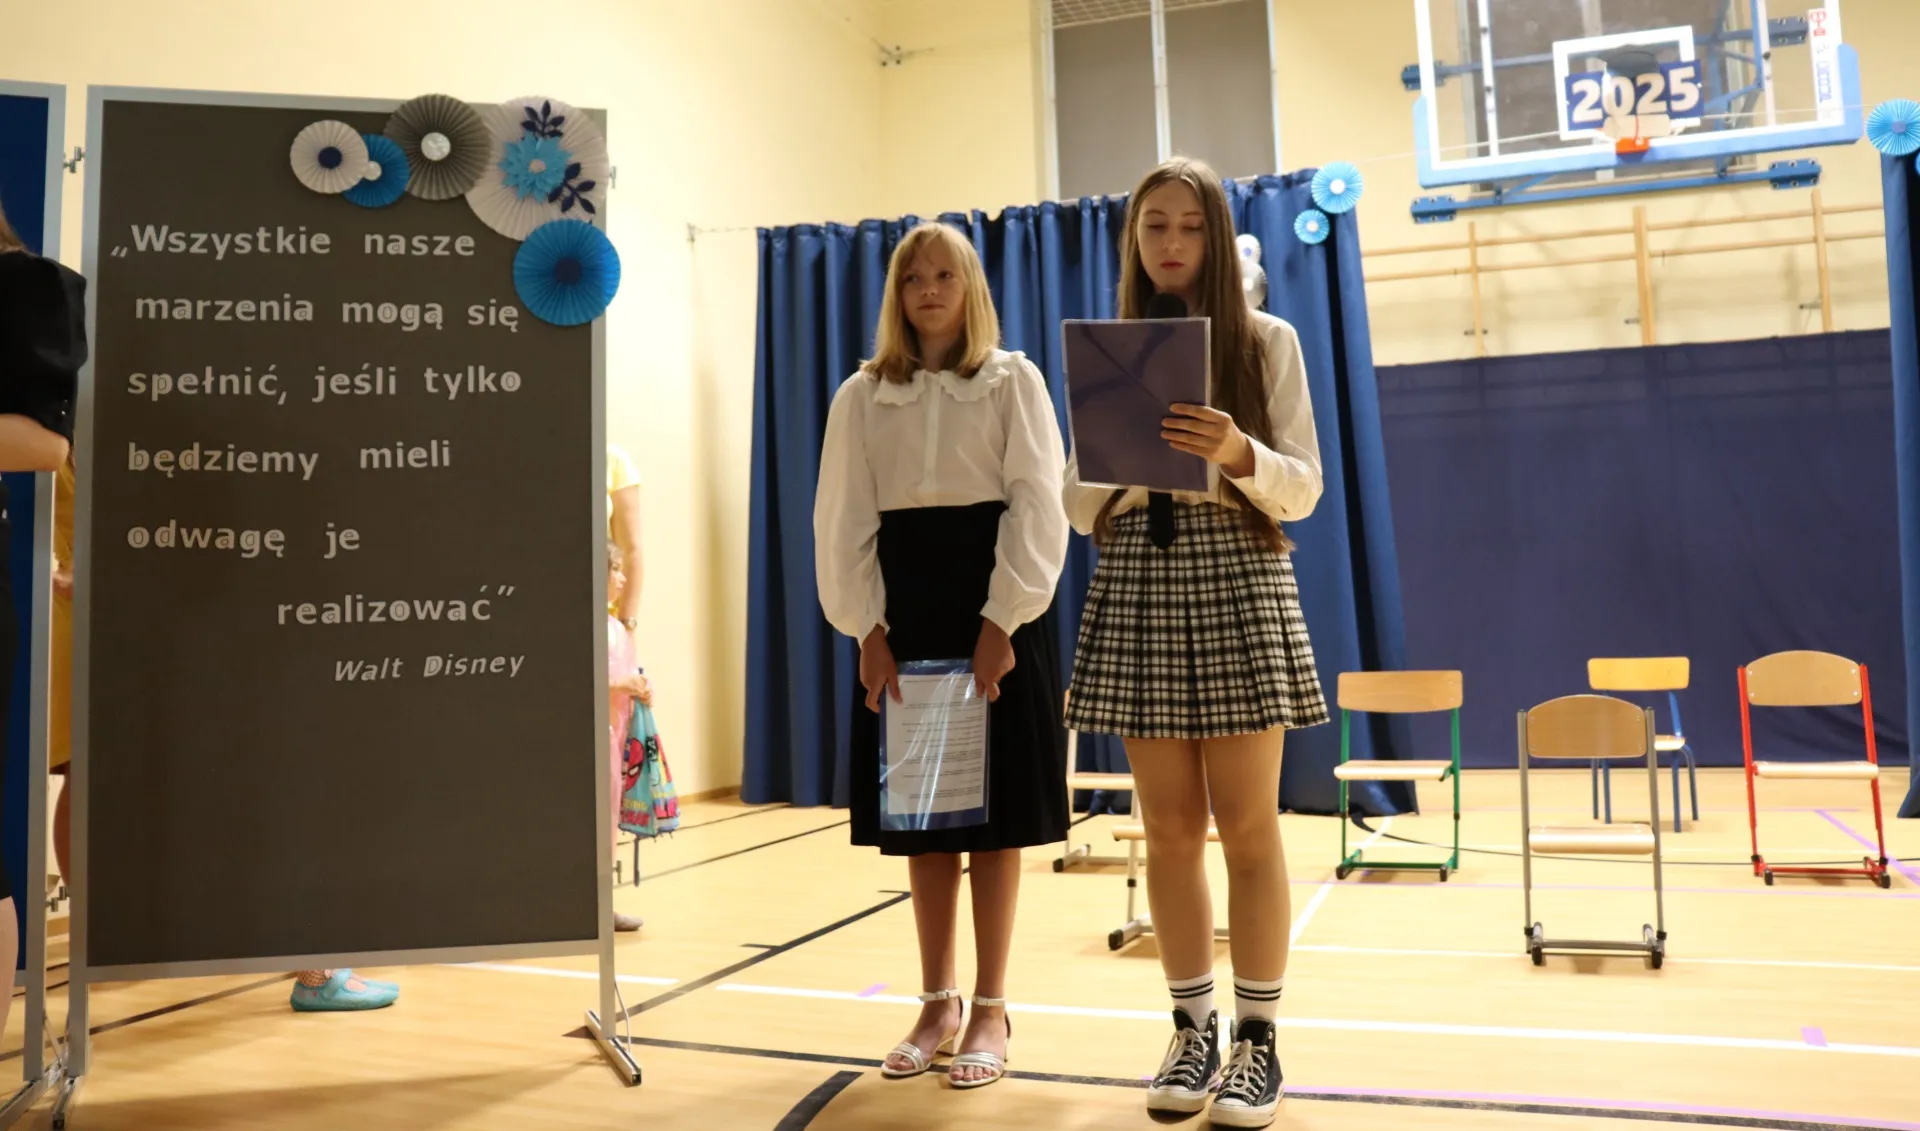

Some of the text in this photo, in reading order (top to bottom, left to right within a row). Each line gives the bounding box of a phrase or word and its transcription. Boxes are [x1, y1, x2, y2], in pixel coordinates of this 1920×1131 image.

[1571, 66, 1700, 124] 2025
[364, 233, 476, 257] nasze
[135, 293, 519, 333] marzenia mogą się
[127, 363, 522, 406] spełnić, jeśli tylko
[128, 440, 451, 481] będziemy mieli
[127, 520, 360, 560] odwagę je
[334, 655, 525, 682] Walt Disney
